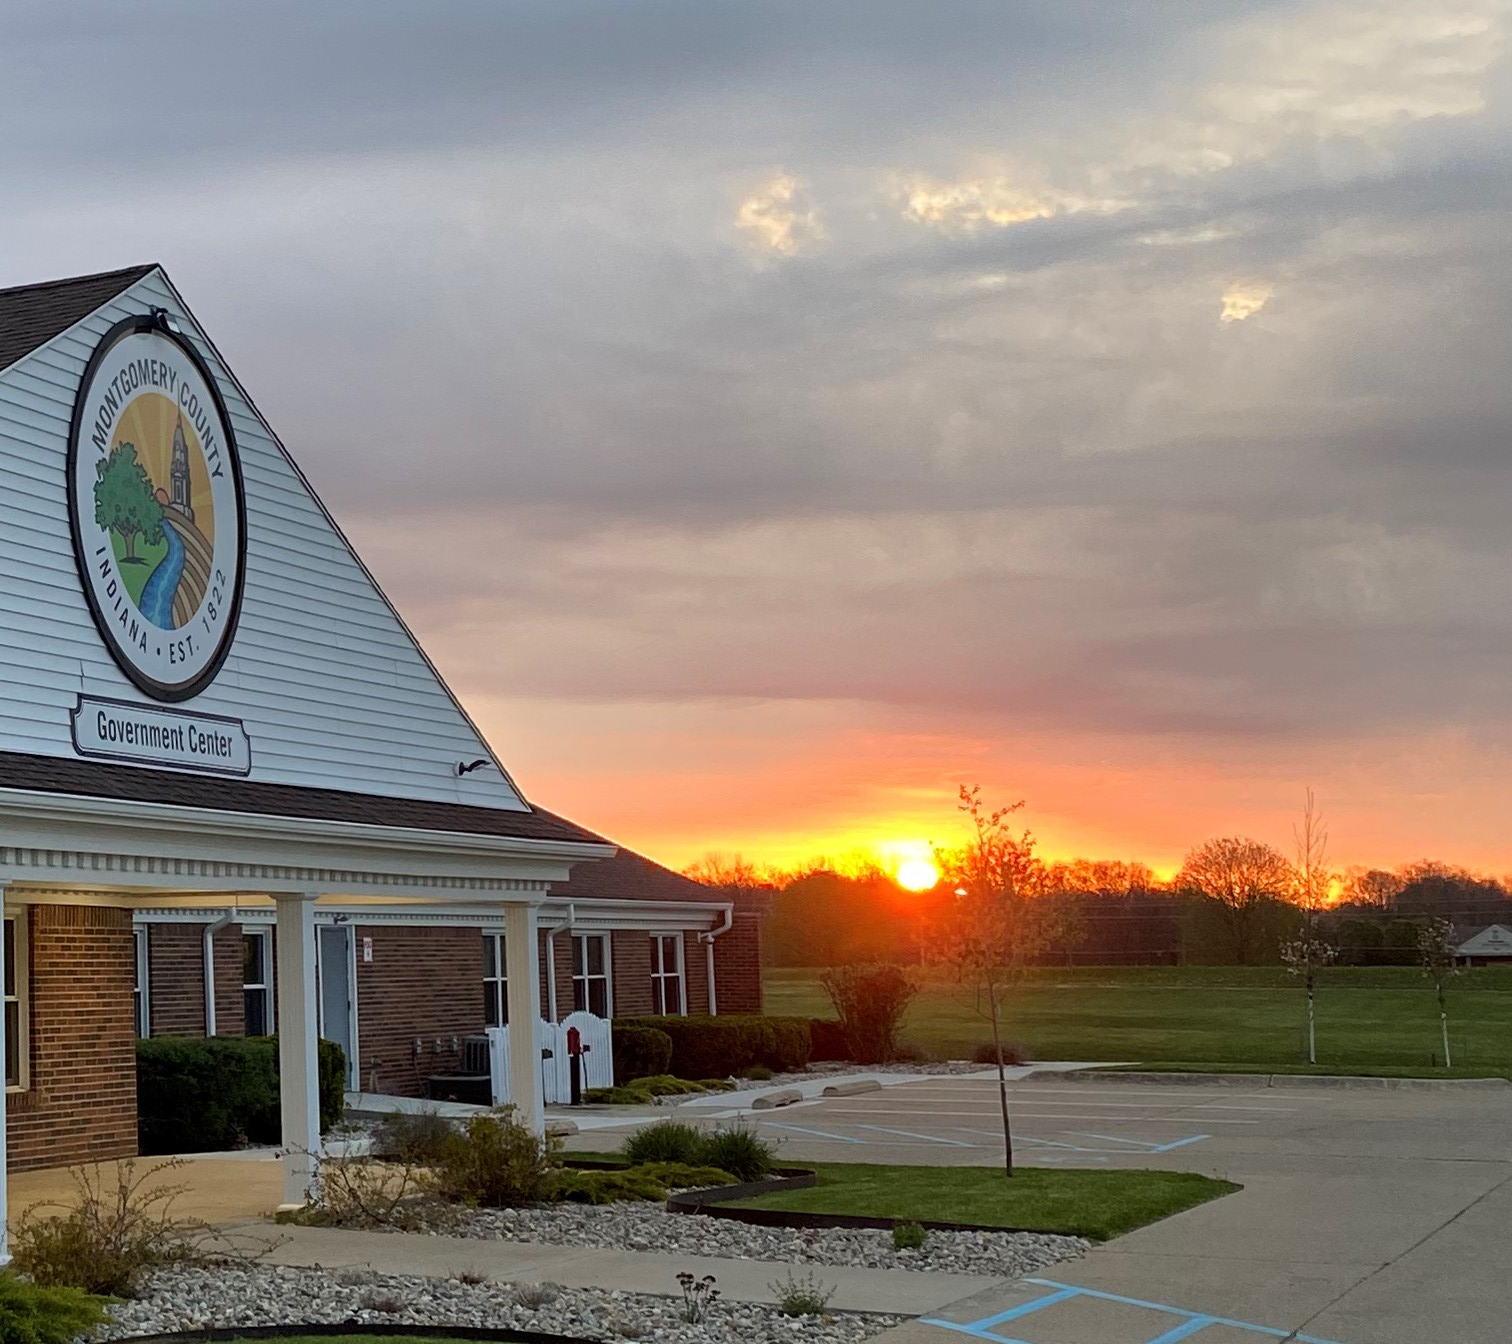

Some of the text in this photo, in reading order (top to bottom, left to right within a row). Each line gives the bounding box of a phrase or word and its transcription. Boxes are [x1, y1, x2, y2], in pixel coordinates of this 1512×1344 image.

[91, 358, 224, 478] MONTGOMERY COUNTY
[96, 546, 226, 664] INDIANA EST. 1822
[97, 710, 232, 757] Government Center
